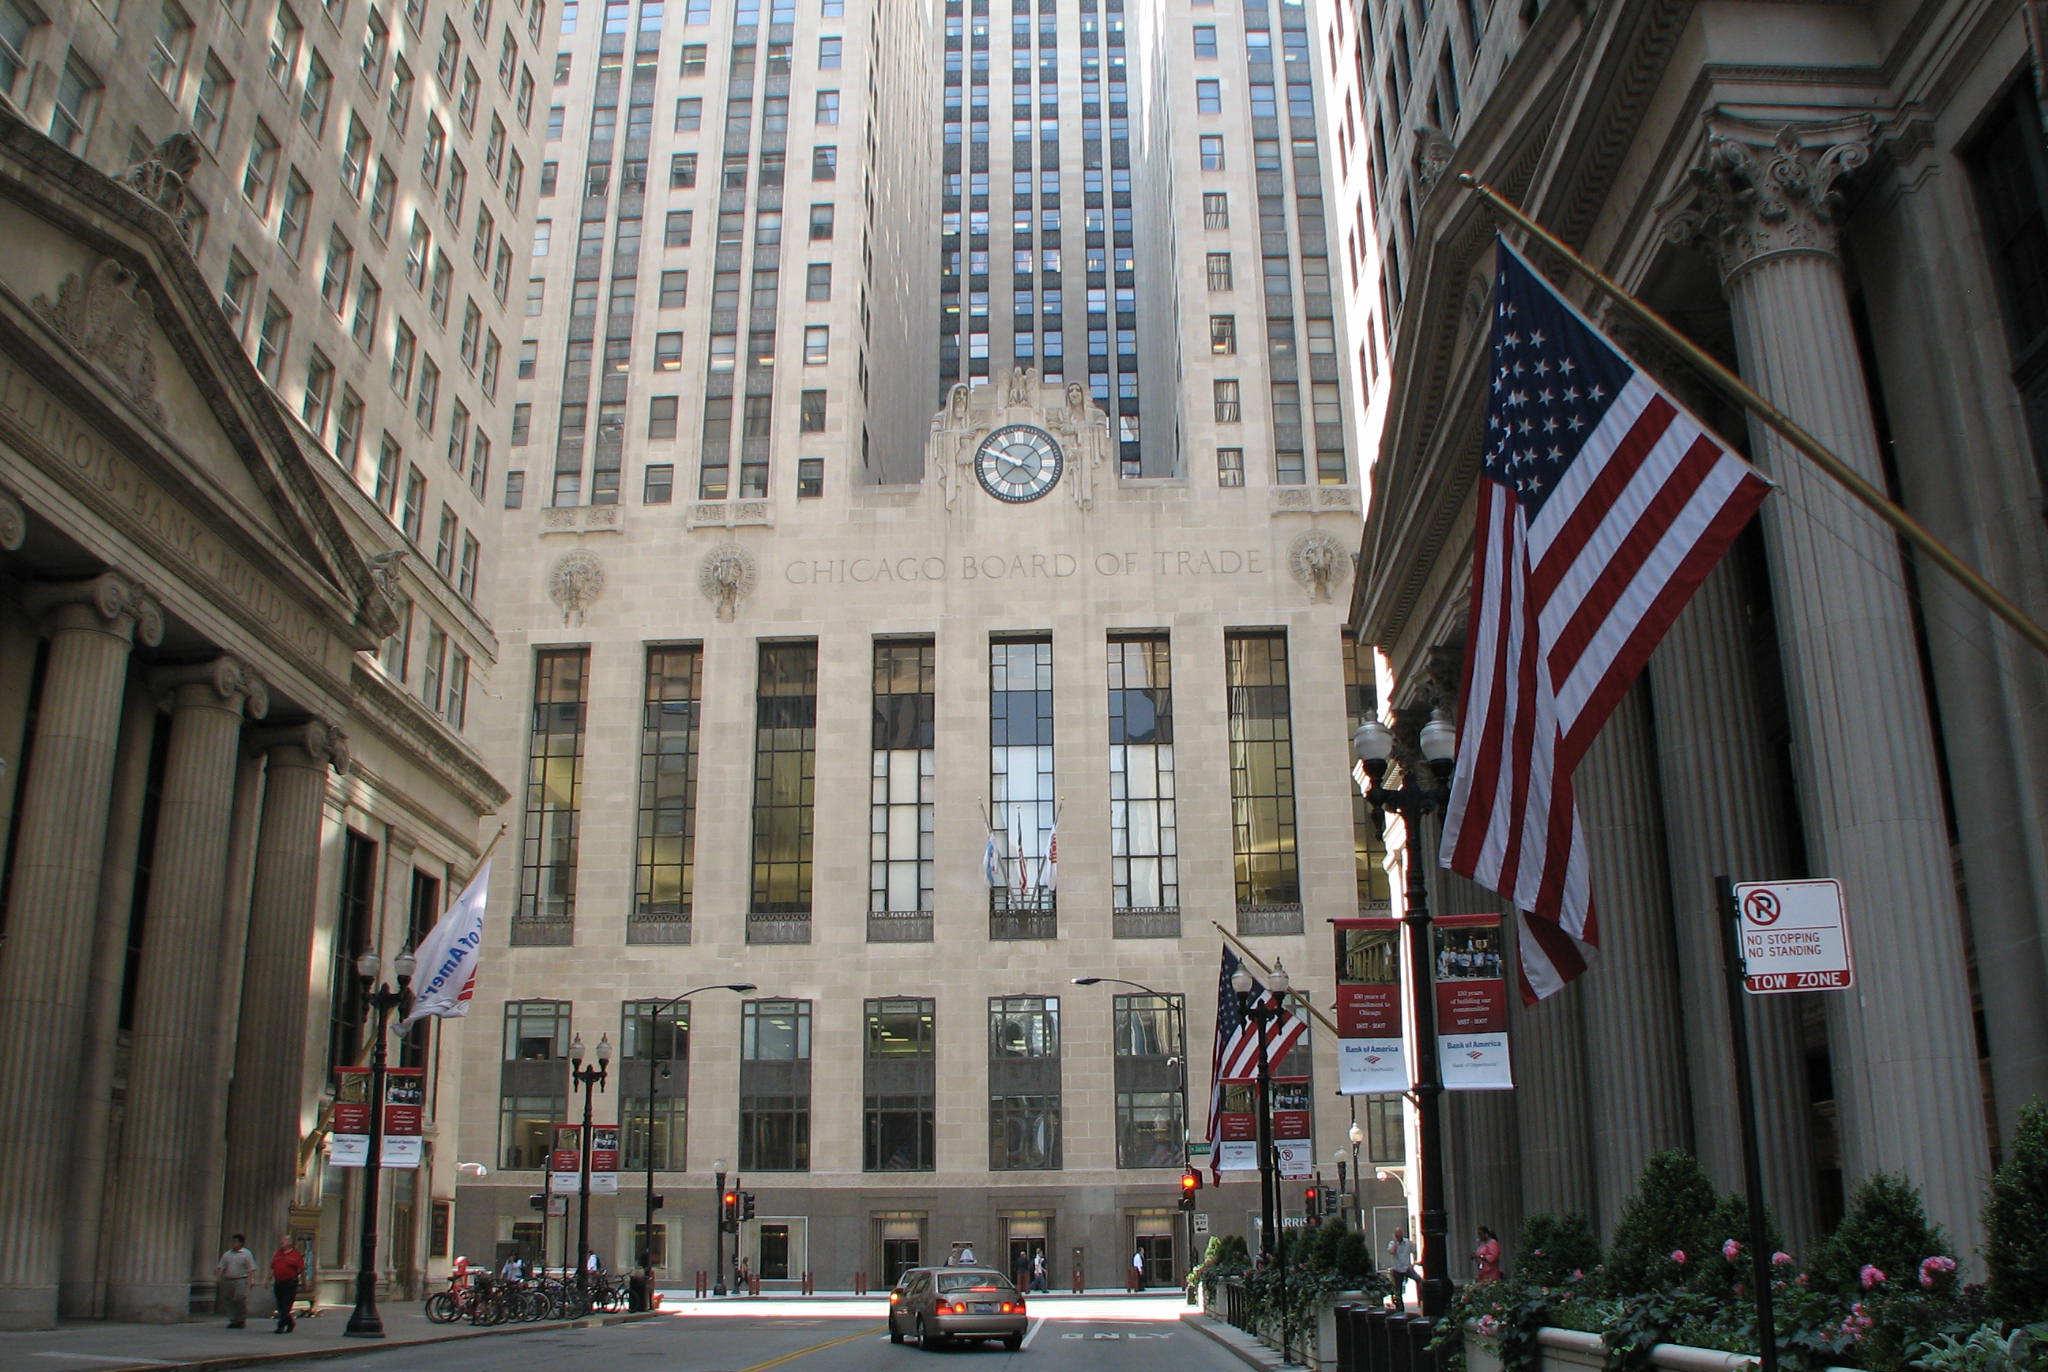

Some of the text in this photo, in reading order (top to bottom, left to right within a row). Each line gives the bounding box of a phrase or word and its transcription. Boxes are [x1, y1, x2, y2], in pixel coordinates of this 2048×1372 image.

[131, 481, 203, 563] BANK
[219, 548, 320, 654] BUILDING
[785, 549, 1265, 585] CHICAGO BOARD OF TRADE
[1747, 932, 1821, 945] NO STOPPING
[1748, 945, 1822, 958] NO STANDING
[1752, 972, 1842, 989] TOW ZONE
[1345, 1045, 1399, 1053] Bank of America
[1447, 1041, 1465, 1049] Bank
[1472, 1040, 1502, 1048] America
[1273, 1217, 1308, 1228] RRIS
